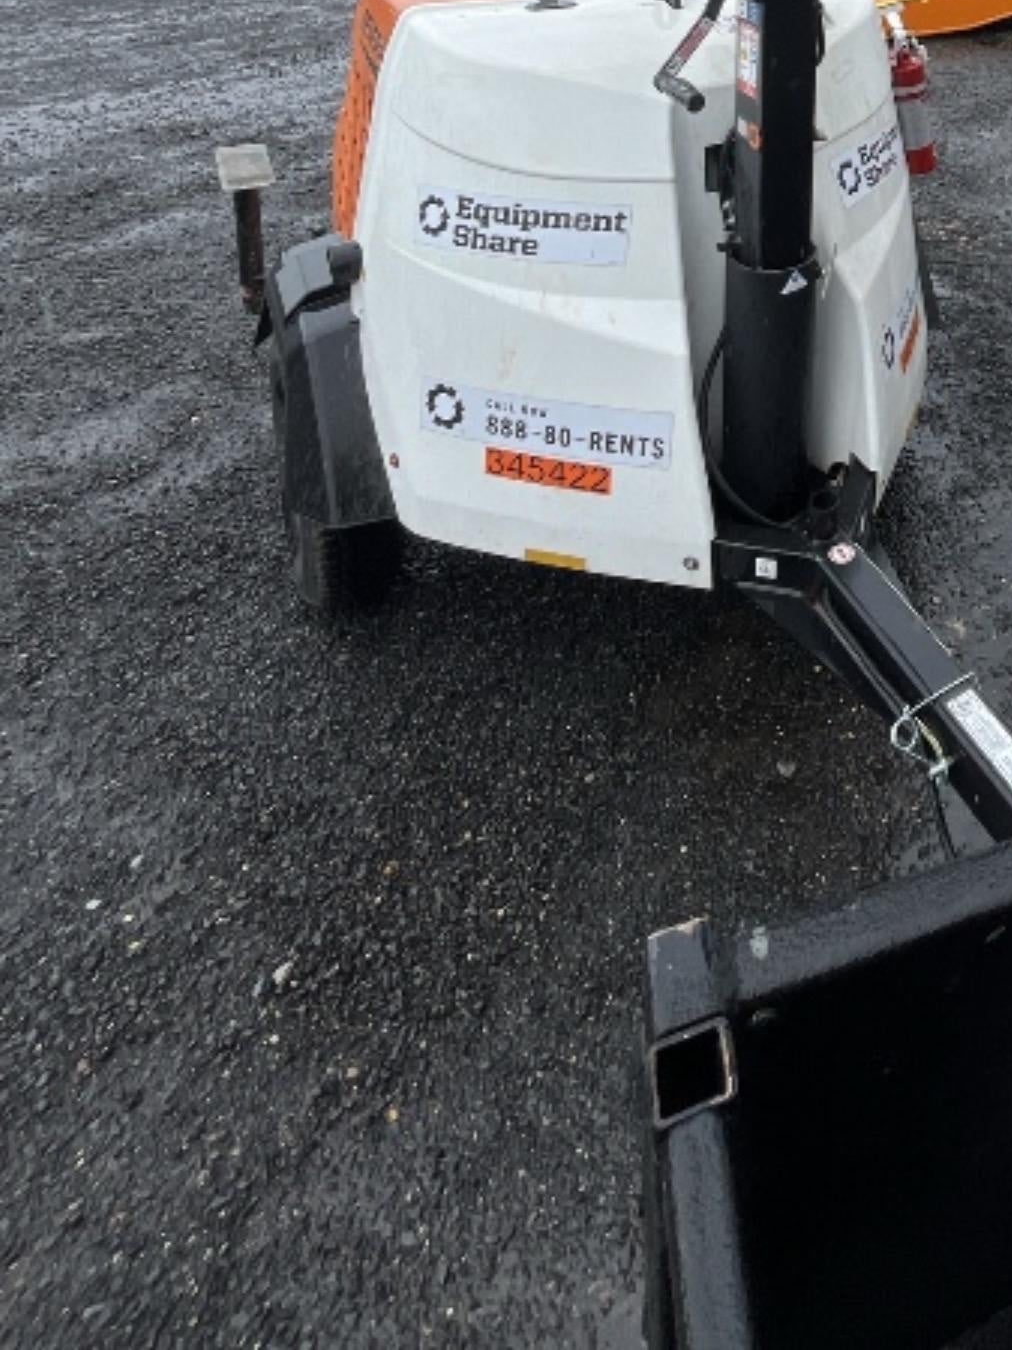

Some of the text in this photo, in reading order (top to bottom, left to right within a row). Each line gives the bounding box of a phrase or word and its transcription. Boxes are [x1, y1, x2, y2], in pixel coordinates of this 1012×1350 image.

[455, 195, 628, 232] Equipment
[453, 224, 539, 256] Share
[485, 413, 666, 460] 888-80-RENTS
[487, 448, 611, 494] 345422
